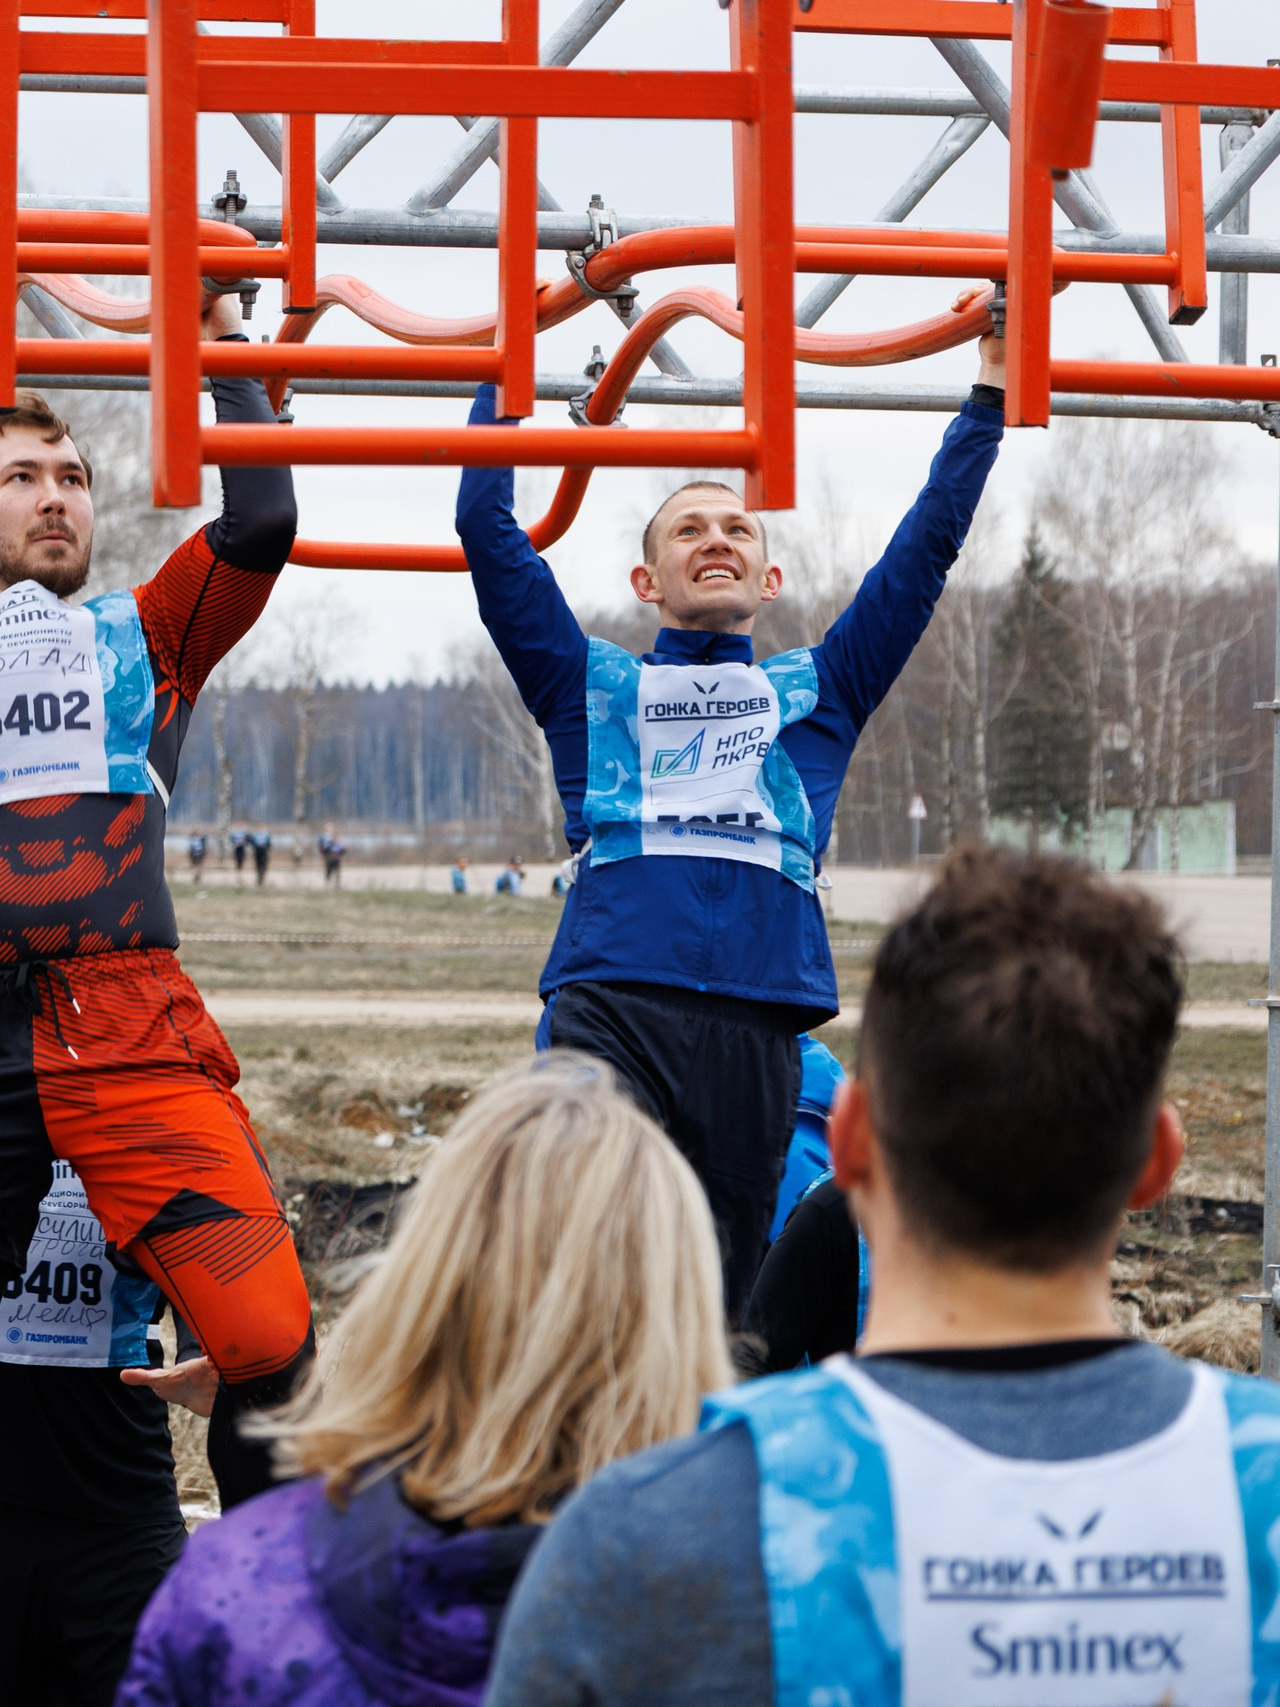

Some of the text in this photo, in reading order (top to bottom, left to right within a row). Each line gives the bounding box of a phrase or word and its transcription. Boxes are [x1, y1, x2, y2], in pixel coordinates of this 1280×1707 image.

[6, 637, 72, 648] DEVELOPMENT
[645, 697, 770, 717] ГОНКА ГЕРОЕВ
[716, 726, 764, 751] НПО
[711, 742, 770, 770] ПКРВ
[12, 761, 80, 778] ГАЗПРОМБАНК
[690, 828, 756, 845] ГАЗПРОМБАНК
[26, 1333, 88, 1345] ГАЗПРОМБАНК
[924, 1553, 1227, 1586] ГОНКА ГЕРОЕВ
[970, 1619, 1186, 1677] Sminex
